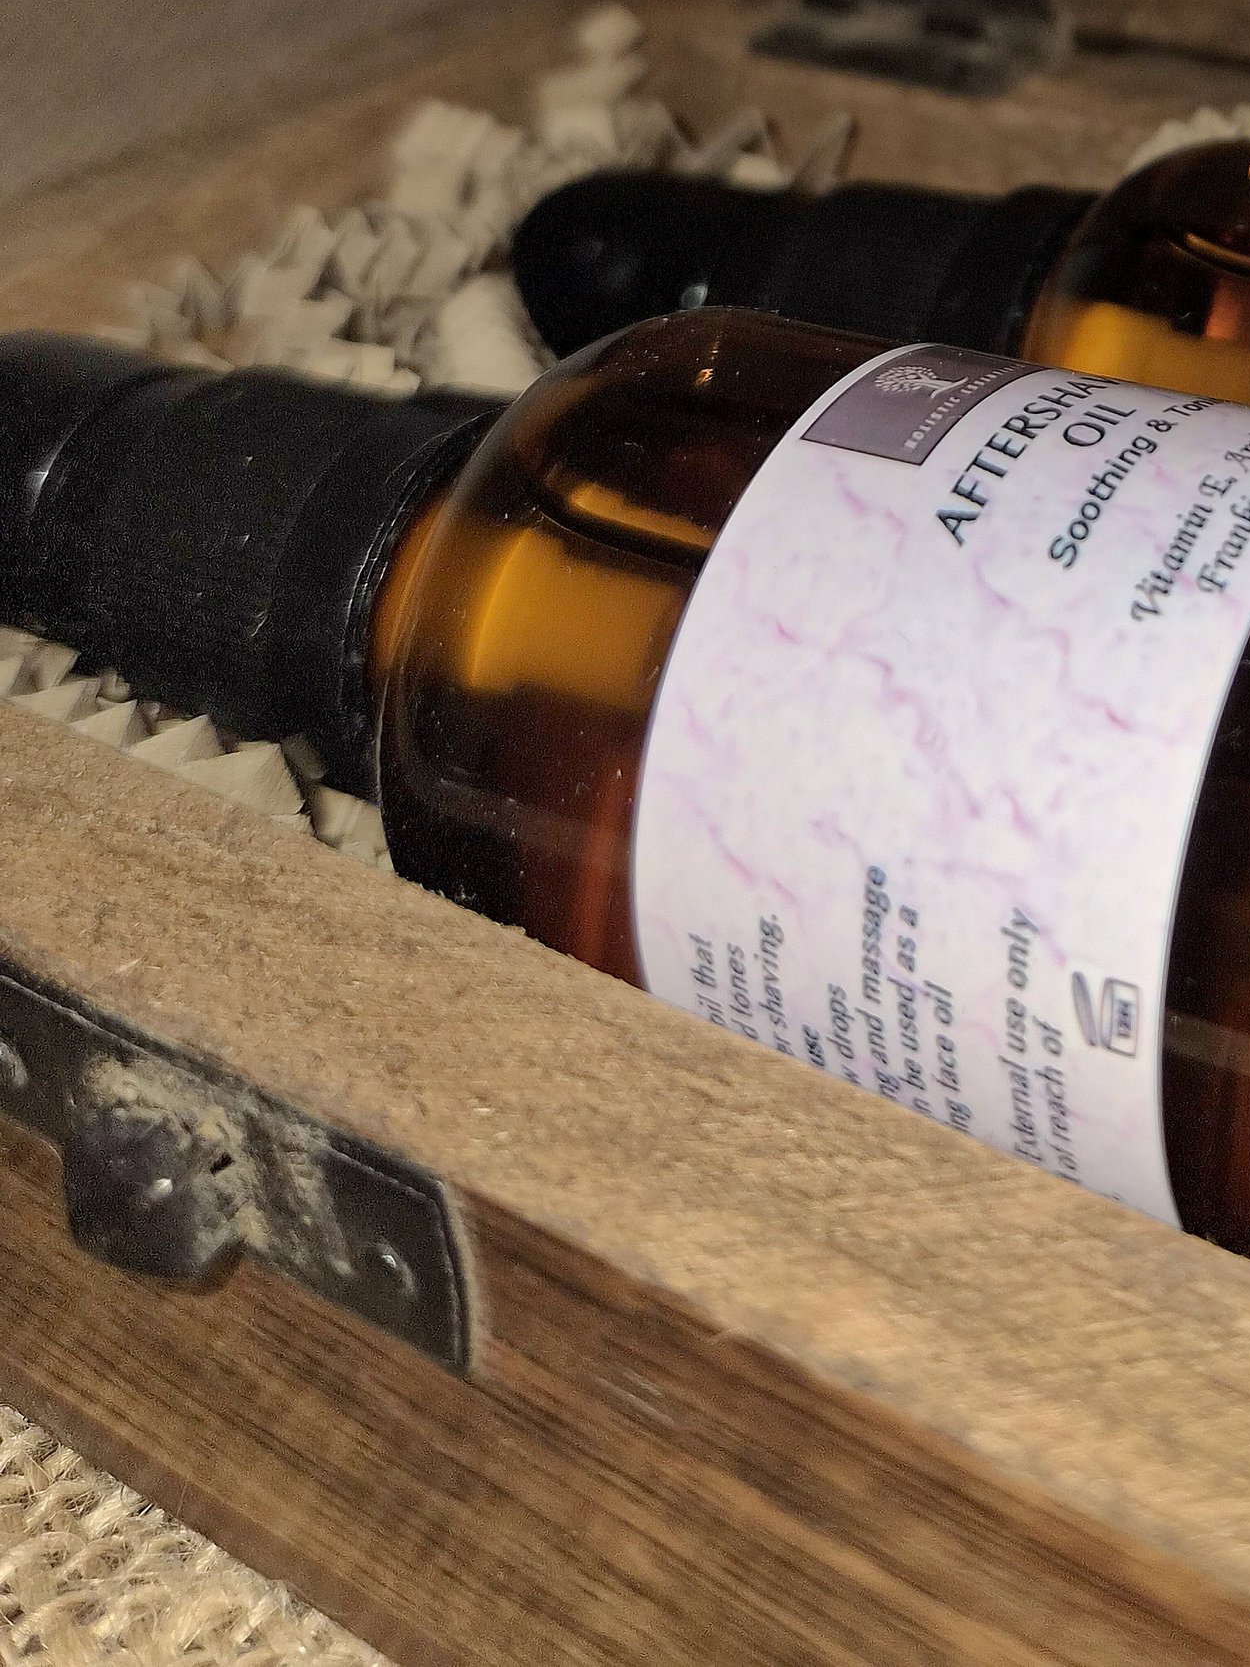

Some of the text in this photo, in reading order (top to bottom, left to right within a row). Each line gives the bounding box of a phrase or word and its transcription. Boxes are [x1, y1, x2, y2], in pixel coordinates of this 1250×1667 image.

[1063, 403, 1137, 447] OIL
[1049, 435, 1158, 569] Soothing
[1146, 419, 1178, 432] &
[1130, 503, 1214, 622] Vitamin
[862, 865, 891, 1005] massage
[900, 904, 919, 928] a
[1000, 906, 1040, 991] only
[687, 932, 717, 989] that
[727, 941, 753, 1017] tones
[752, 913, 788, 1029] shaving.
[897, 934, 917, 973] as
[826, 982, 855, 1060] drops
[855, 1007, 888, 1066] and
[887, 976, 920, 1053] used
[922, 980, 953, 1026] oil
[1006, 998, 1027, 1054] use
[1032, 1014, 1063, 1057] of
[899, 1057, 926, 1091] be
[1034, 1066, 1072, 1142] reach
